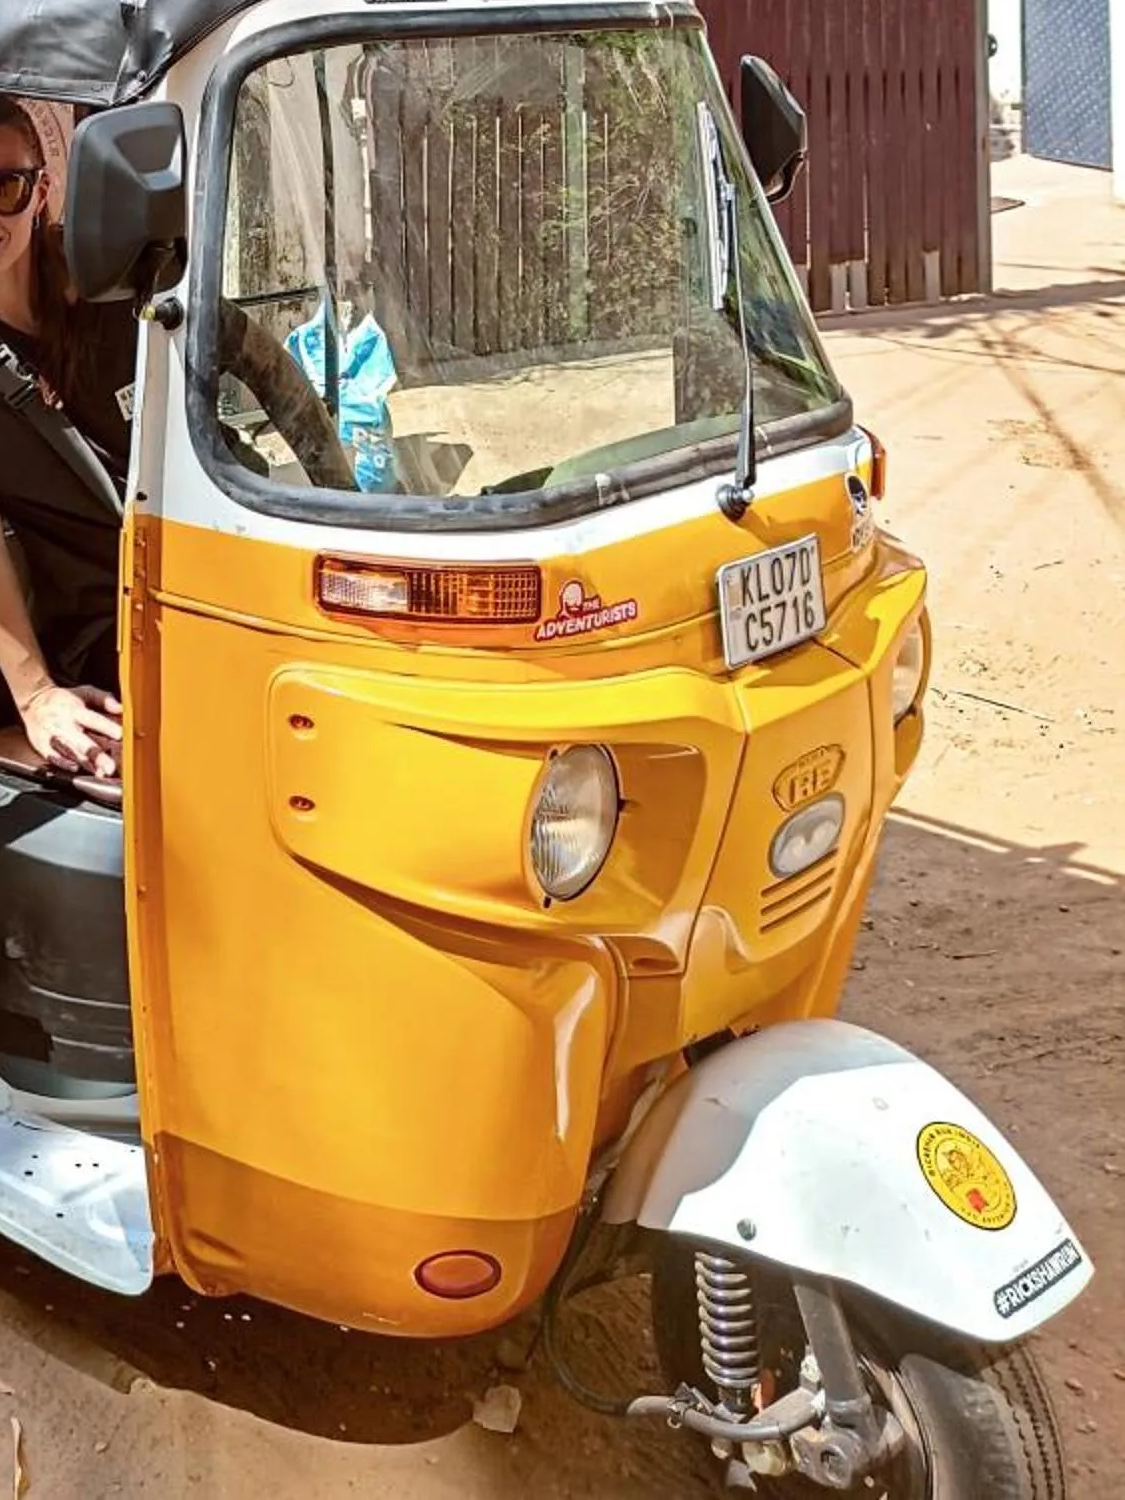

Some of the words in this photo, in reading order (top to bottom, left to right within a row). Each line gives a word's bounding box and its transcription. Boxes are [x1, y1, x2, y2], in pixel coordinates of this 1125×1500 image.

[536, 601, 636, 640] ADVENTURISTS
[582, 598, 600, 612] THE
[746, 590, 815, 652] C5716
